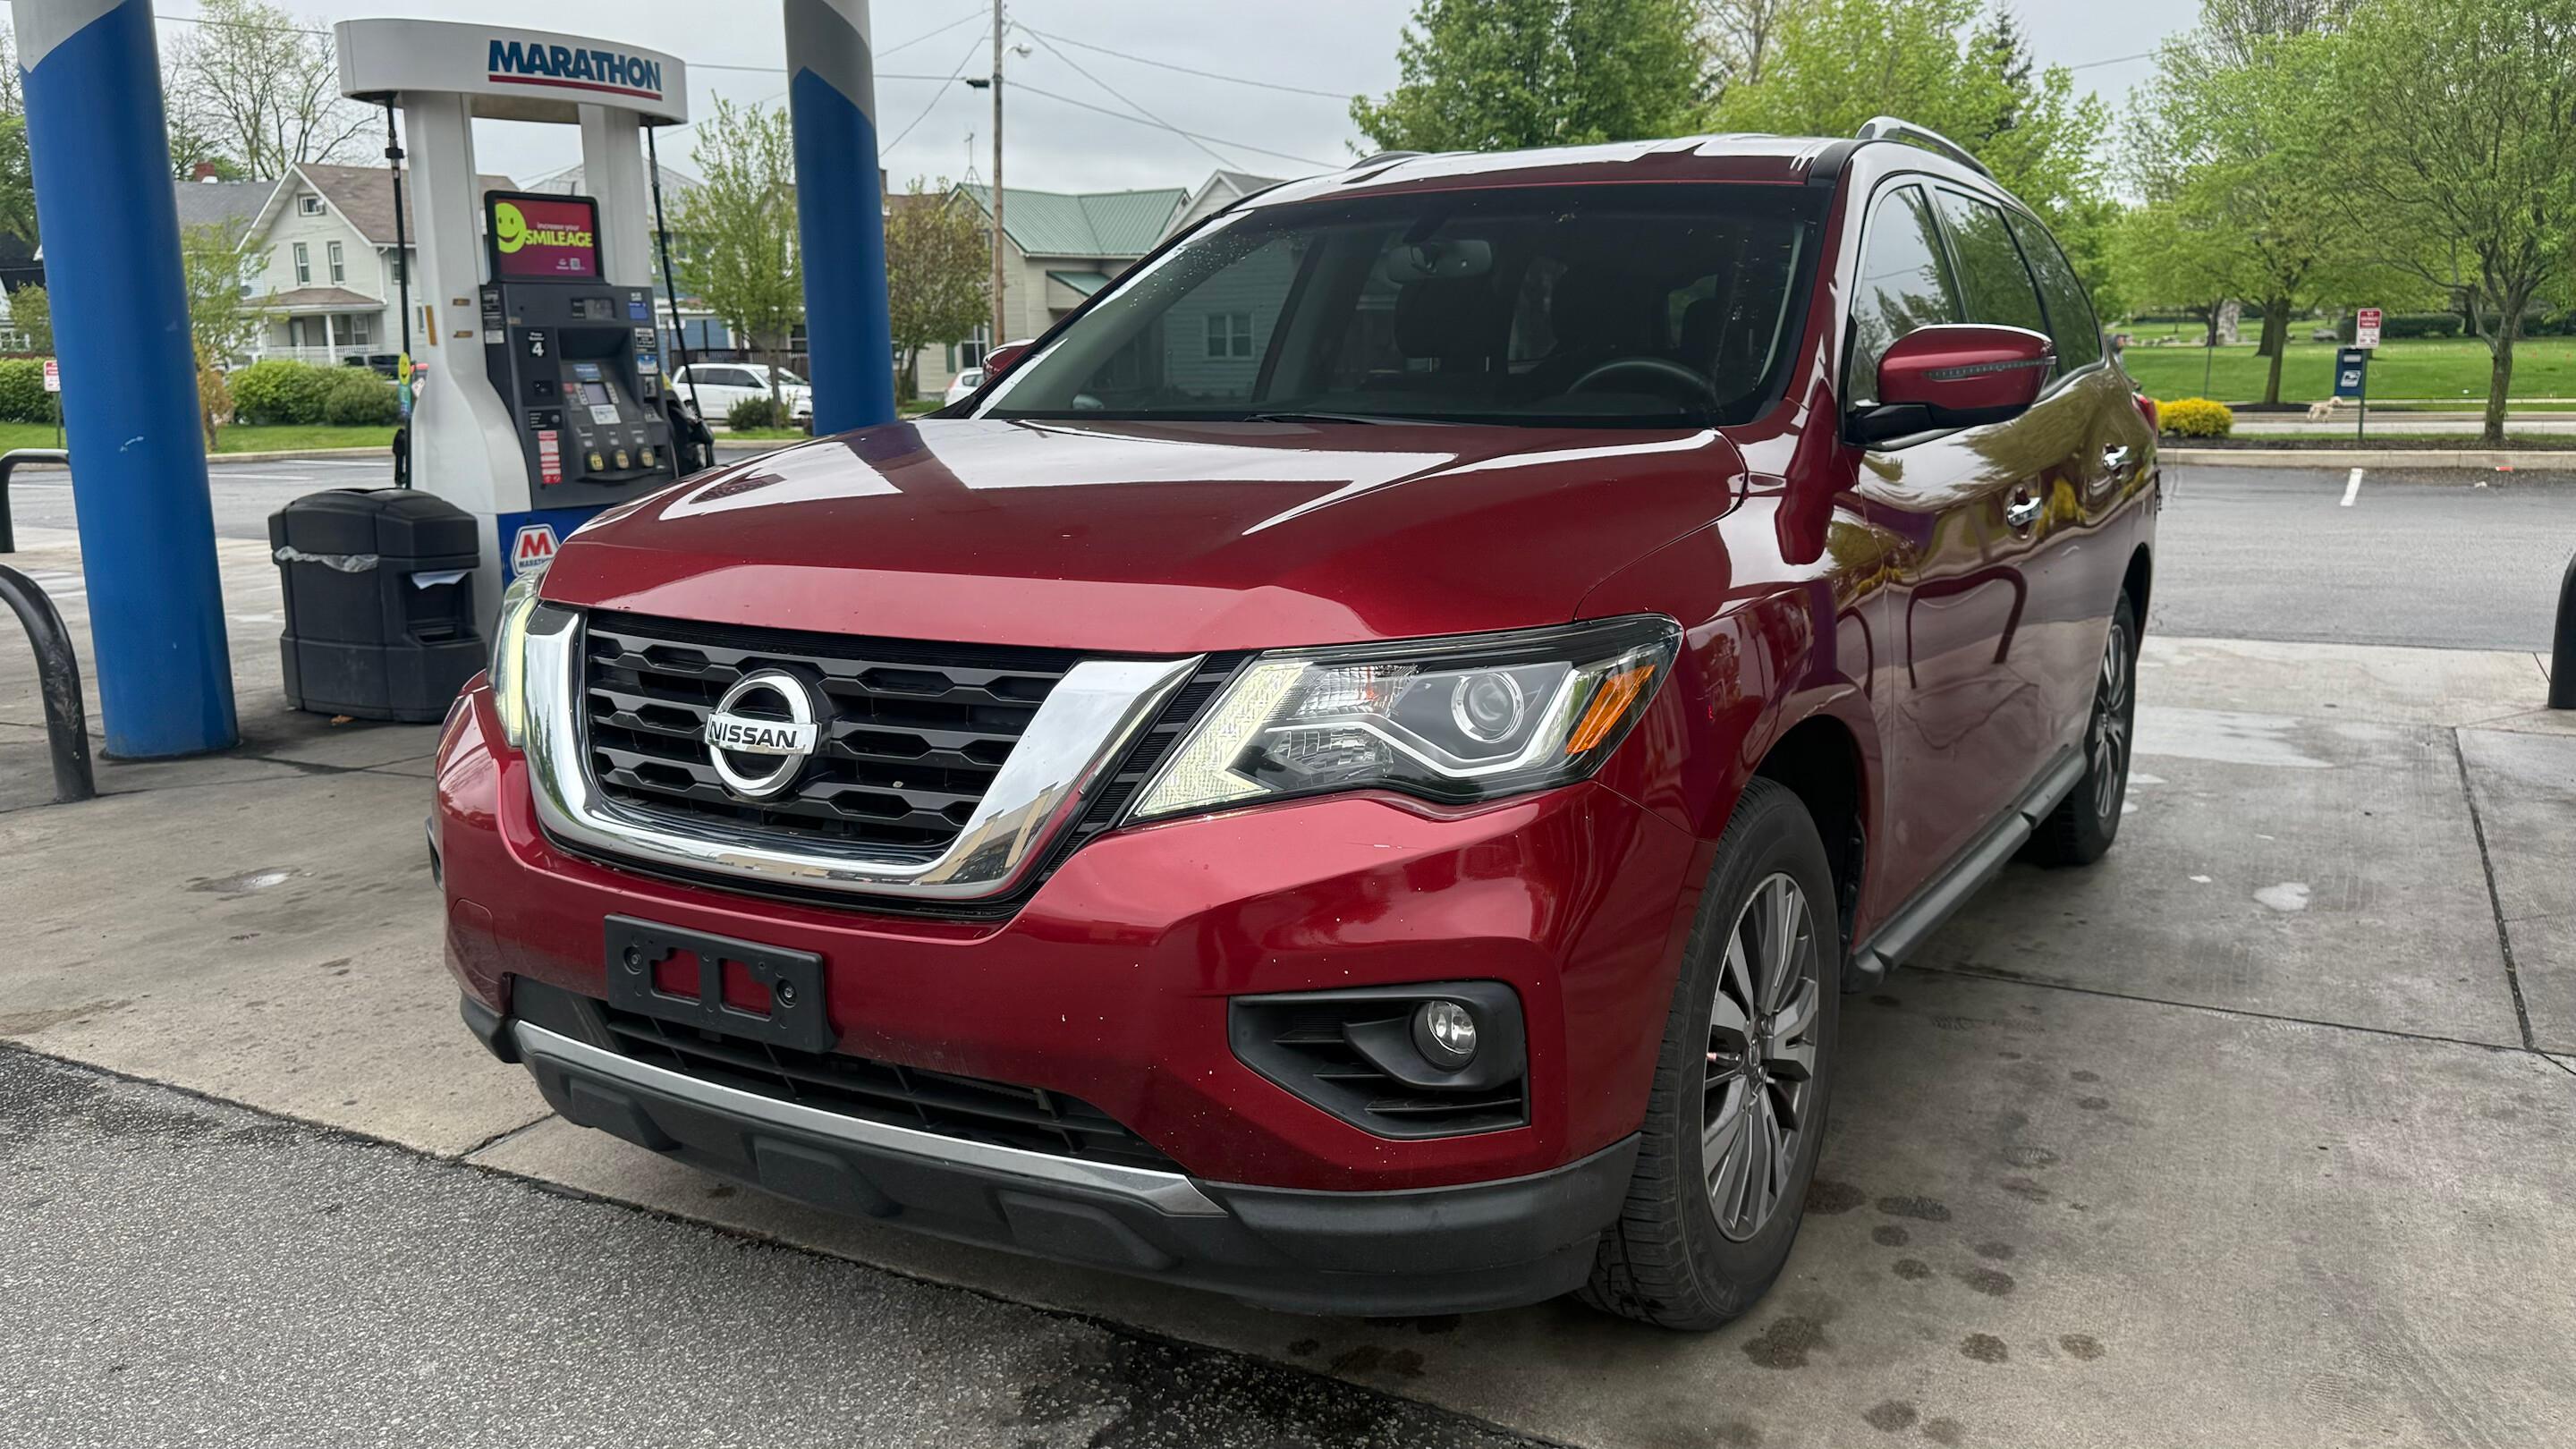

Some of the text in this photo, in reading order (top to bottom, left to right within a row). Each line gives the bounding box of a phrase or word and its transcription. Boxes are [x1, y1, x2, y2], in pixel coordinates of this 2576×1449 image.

[488, 39, 662, 91] MARATHON
[525, 229, 594, 248] SMILEAGE
[531, 342, 545, 357] 4
[521, 532, 554, 558] M
[709, 720, 797, 749] NISSAN
